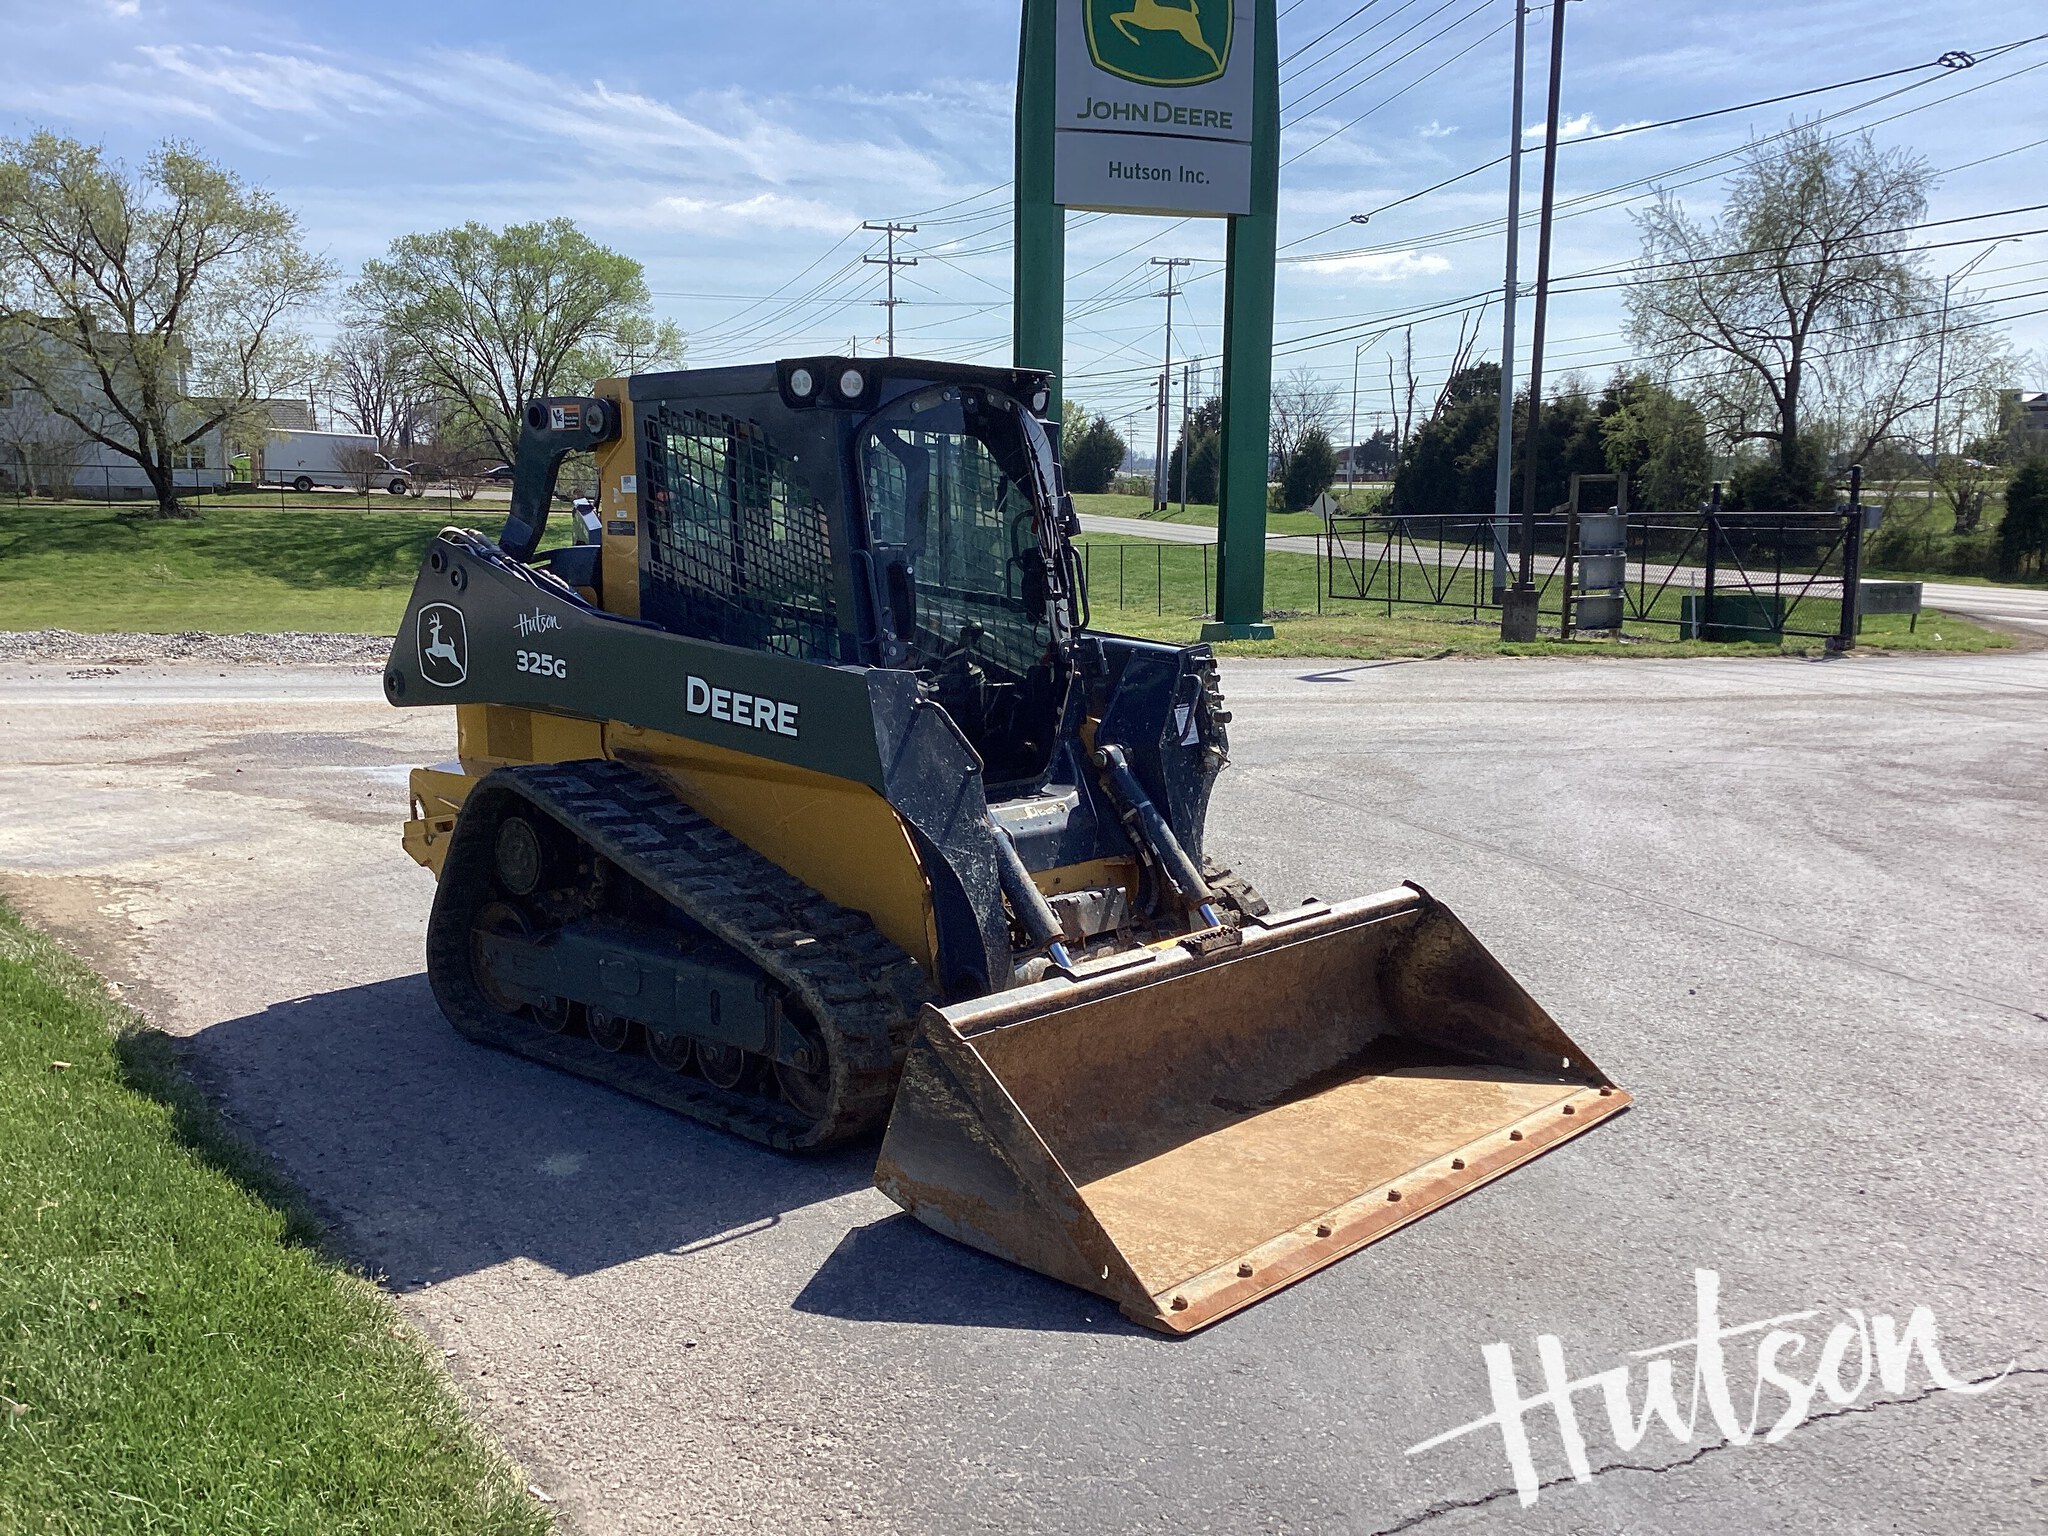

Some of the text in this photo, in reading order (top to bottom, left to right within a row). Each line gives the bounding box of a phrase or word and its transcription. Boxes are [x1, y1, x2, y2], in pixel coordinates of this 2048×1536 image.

[1076, 97, 1233, 130] JOHN DEERE
[1108, 161, 1210, 185] Hutson Inc.
[513, 606, 562, 638] Hutson
[516, 650, 566, 679] 325G
[686, 675, 799, 737] DEERE
